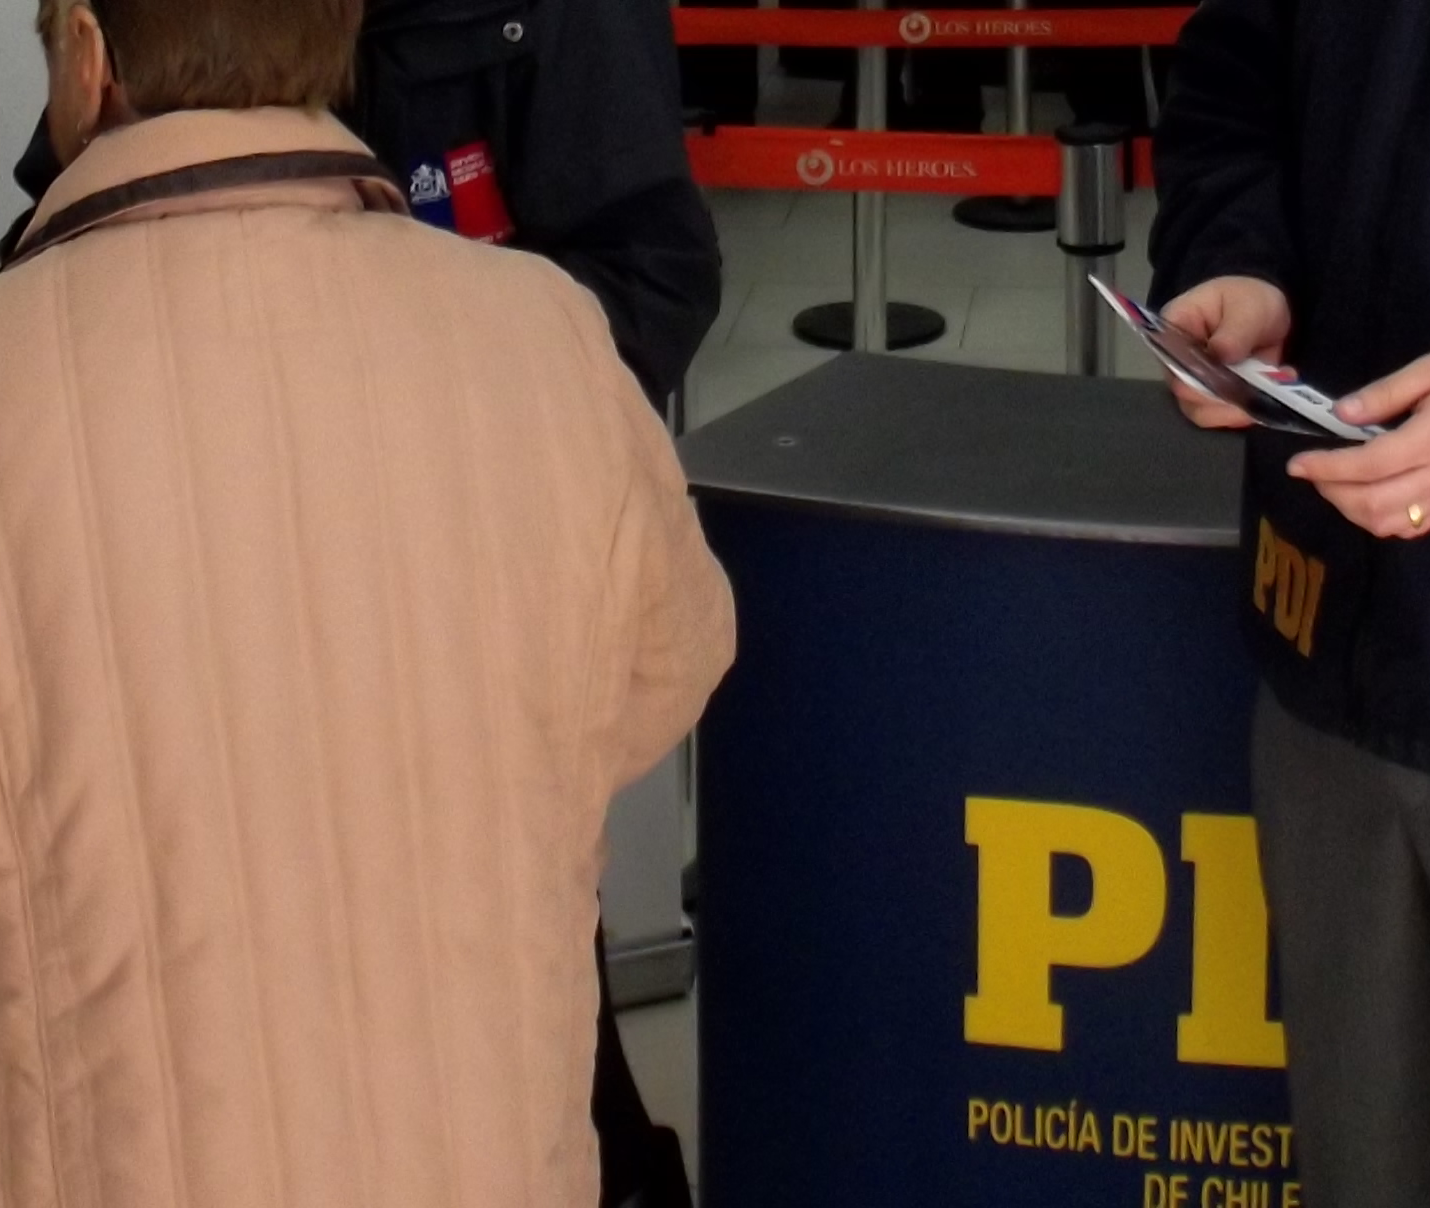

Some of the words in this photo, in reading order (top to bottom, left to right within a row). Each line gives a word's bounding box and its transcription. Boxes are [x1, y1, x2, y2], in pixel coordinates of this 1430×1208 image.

[934, 20, 970, 35] LOS
[975, 19, 1053, 36] HEROES
[838, 158, 878, 176] LOS
[885, 159, 978, 178] HEROES
[1253, 514, 1328, 658] PDI
[967, 1098, 1102, 1155] POLICÍA
[1111, 1113, 1159, 1163] DE
[1169, 1119, 1295, 1170] INVEST
[1143, 1172, 1190, 1208] DE
